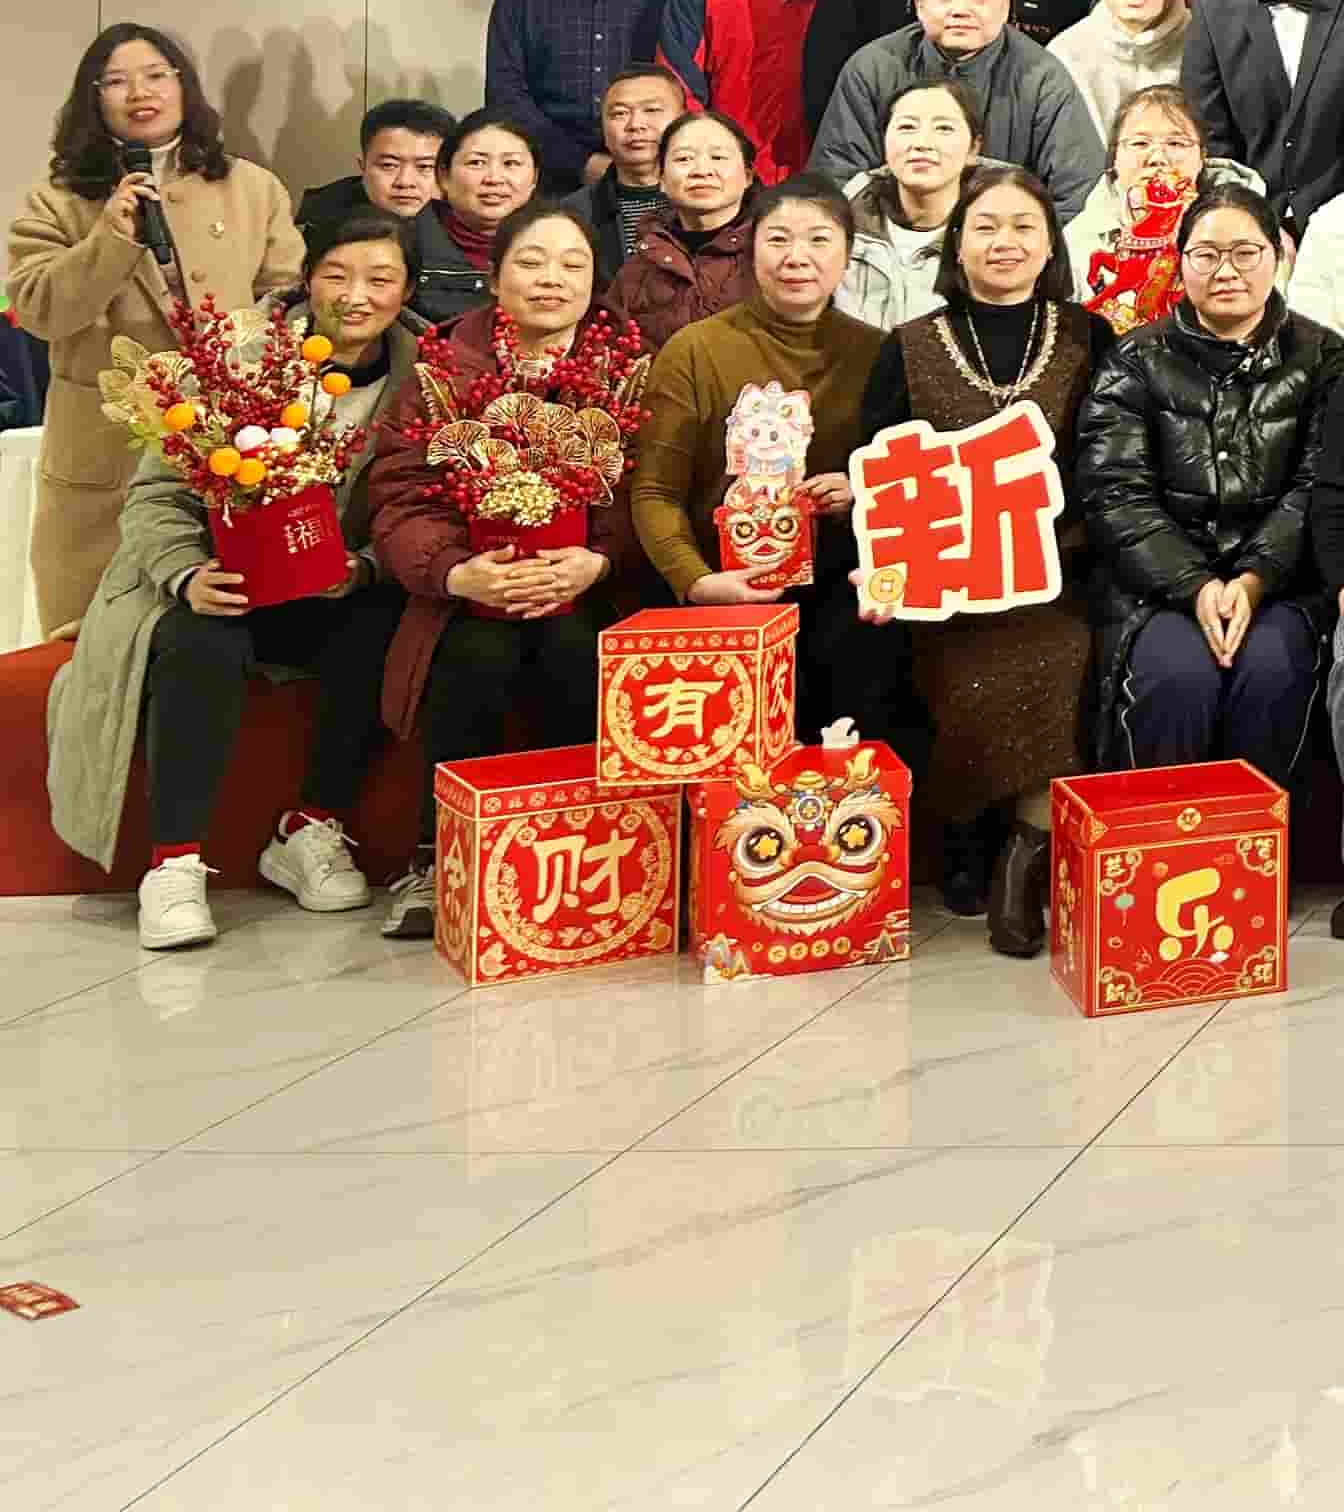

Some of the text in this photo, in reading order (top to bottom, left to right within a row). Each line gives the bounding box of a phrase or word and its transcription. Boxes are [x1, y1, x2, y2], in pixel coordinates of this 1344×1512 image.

[863, 413, 1050, 609] 新
[642, 677, 725, 740] 有
[531, 828, 639, 925] 财
[1155, 866, 1235, 960] 乐
